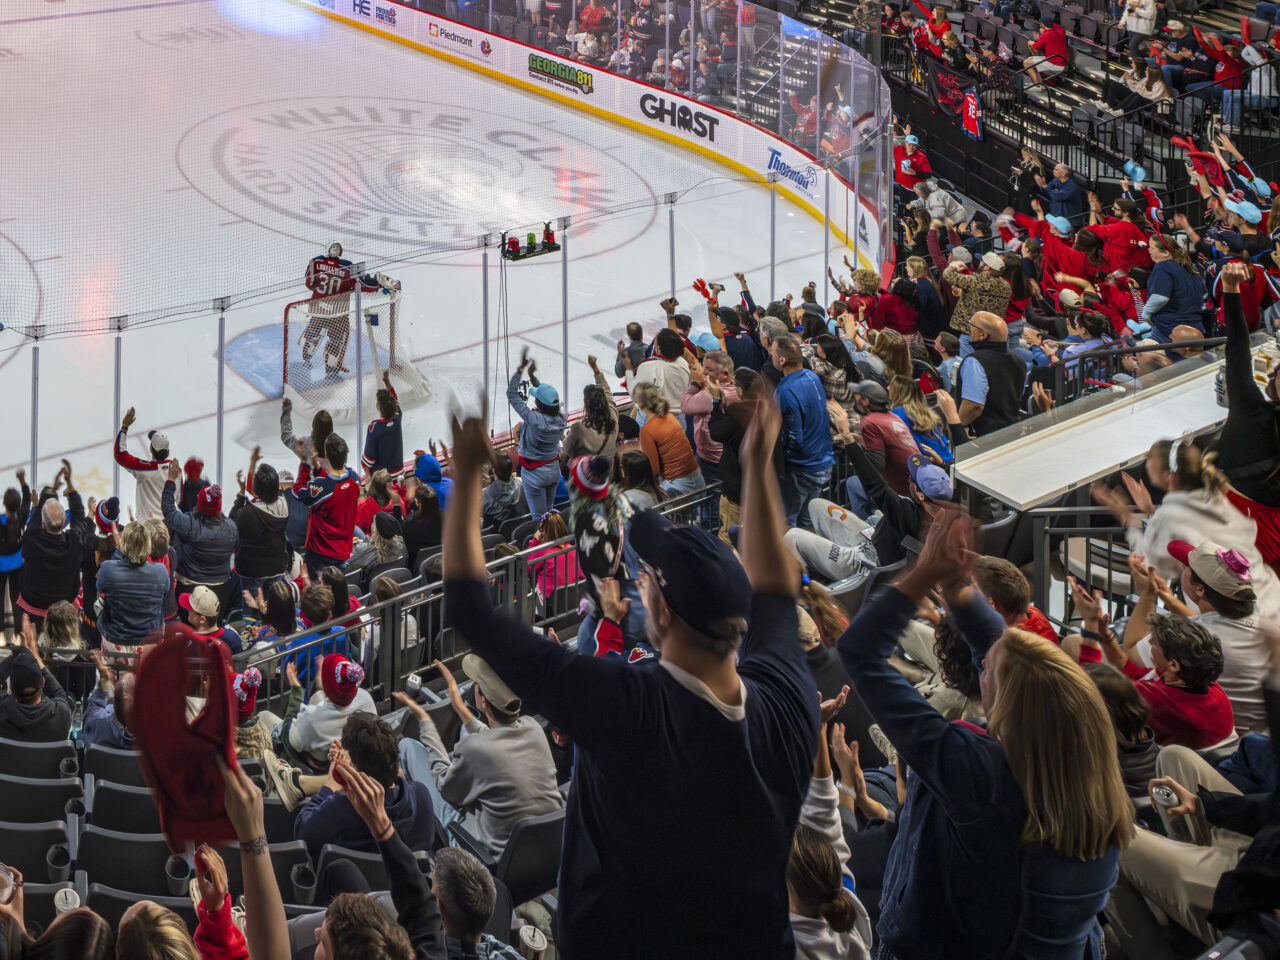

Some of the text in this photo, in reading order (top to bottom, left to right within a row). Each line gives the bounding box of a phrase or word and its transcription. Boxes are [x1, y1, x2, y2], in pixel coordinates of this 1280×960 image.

[439, 27, 473, 48] Piedmont
[254, 105, 471, 133] WHITE
[233, 141, 293, 197] HARD
[767, 145, 810, 190] Thornton
[317, 274, 342, 296] 30
